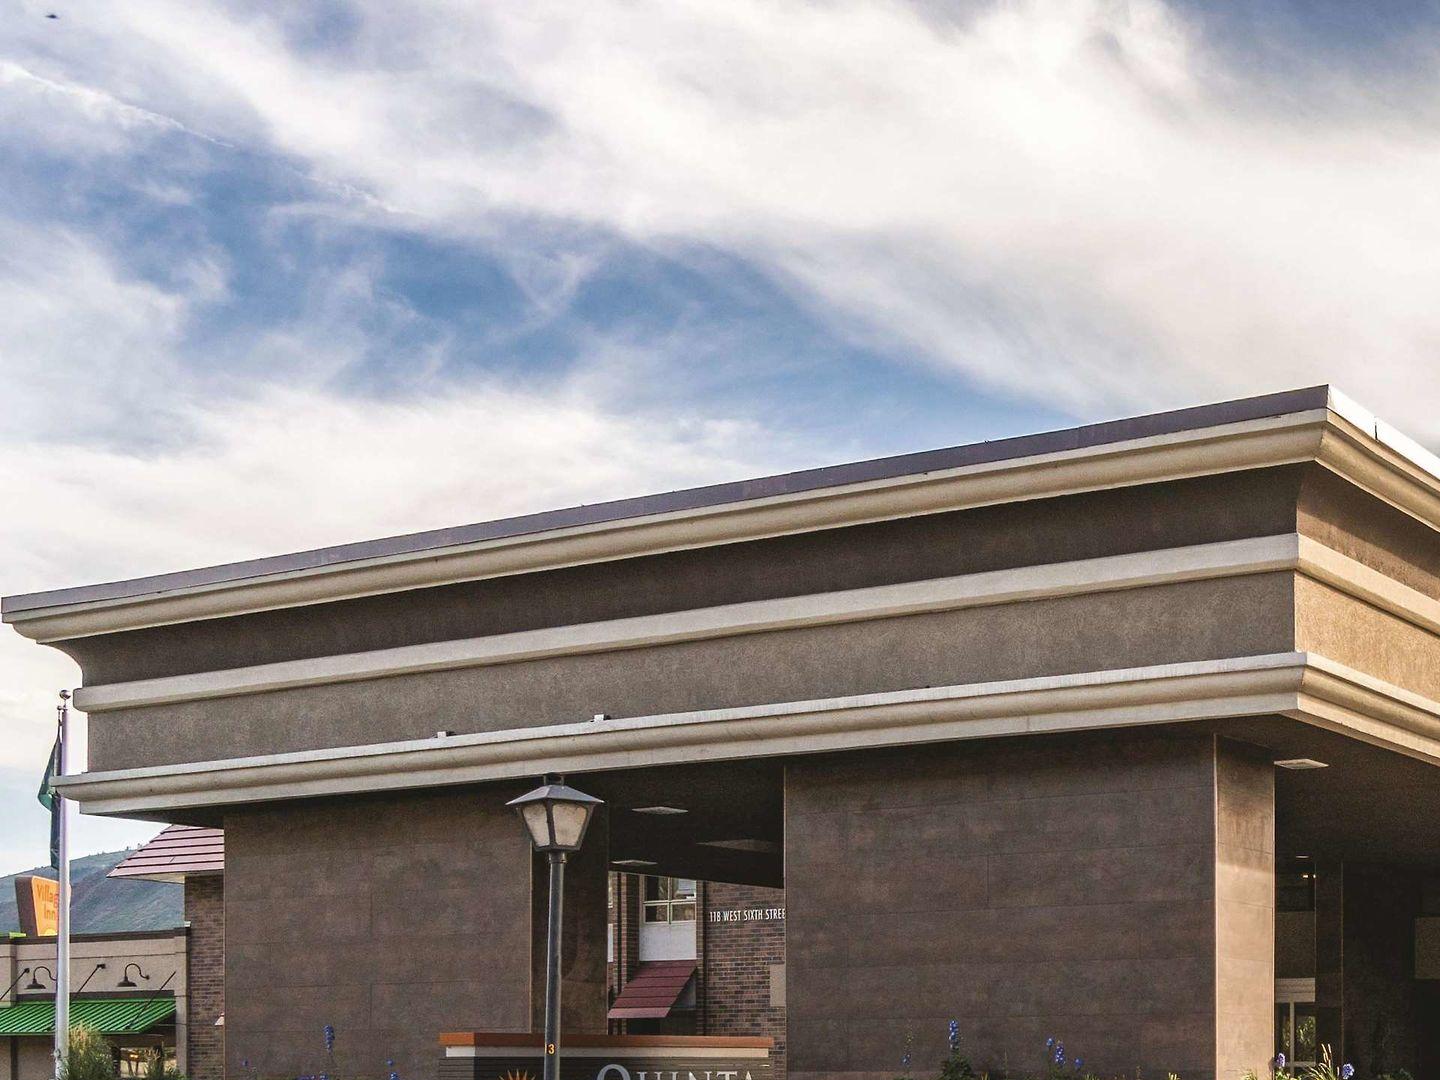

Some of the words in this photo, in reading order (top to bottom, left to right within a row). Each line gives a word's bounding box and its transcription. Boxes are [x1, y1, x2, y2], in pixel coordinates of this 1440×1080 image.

[36, 883, 59, 909] Villag
[44, 903, 57, 920] Inn
[709, 911, 721, 922] 118
[723, 910, 741, 922] WEST
[743, 909, 763, 921] SIXTH
[765, 908, 786, 920] STREE
